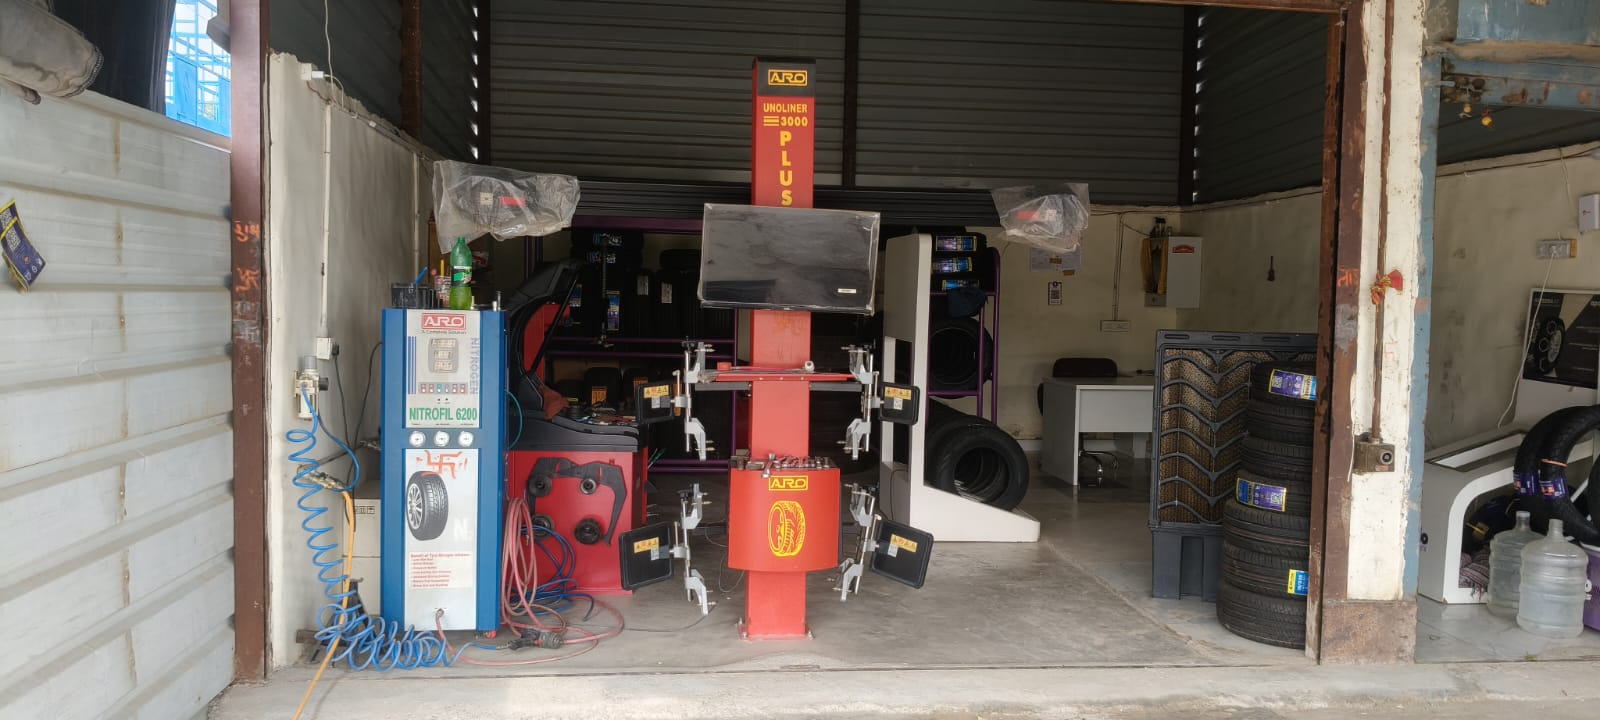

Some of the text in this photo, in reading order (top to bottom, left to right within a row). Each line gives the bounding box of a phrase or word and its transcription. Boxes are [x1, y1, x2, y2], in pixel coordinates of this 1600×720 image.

[770, 71, 806, 83] ARO
[763, 103, 808, 113] UNOLINER
[780, 116, 808, 127] 3000
[779, 131, 793, 206] PLUS
[424, 316, 464, 327] ARO
[470, 337, 480, 395] NITROGEN
[409, 407, 477, 420] NITROFIL 6200
[771, 478, 805, 488] ARO
